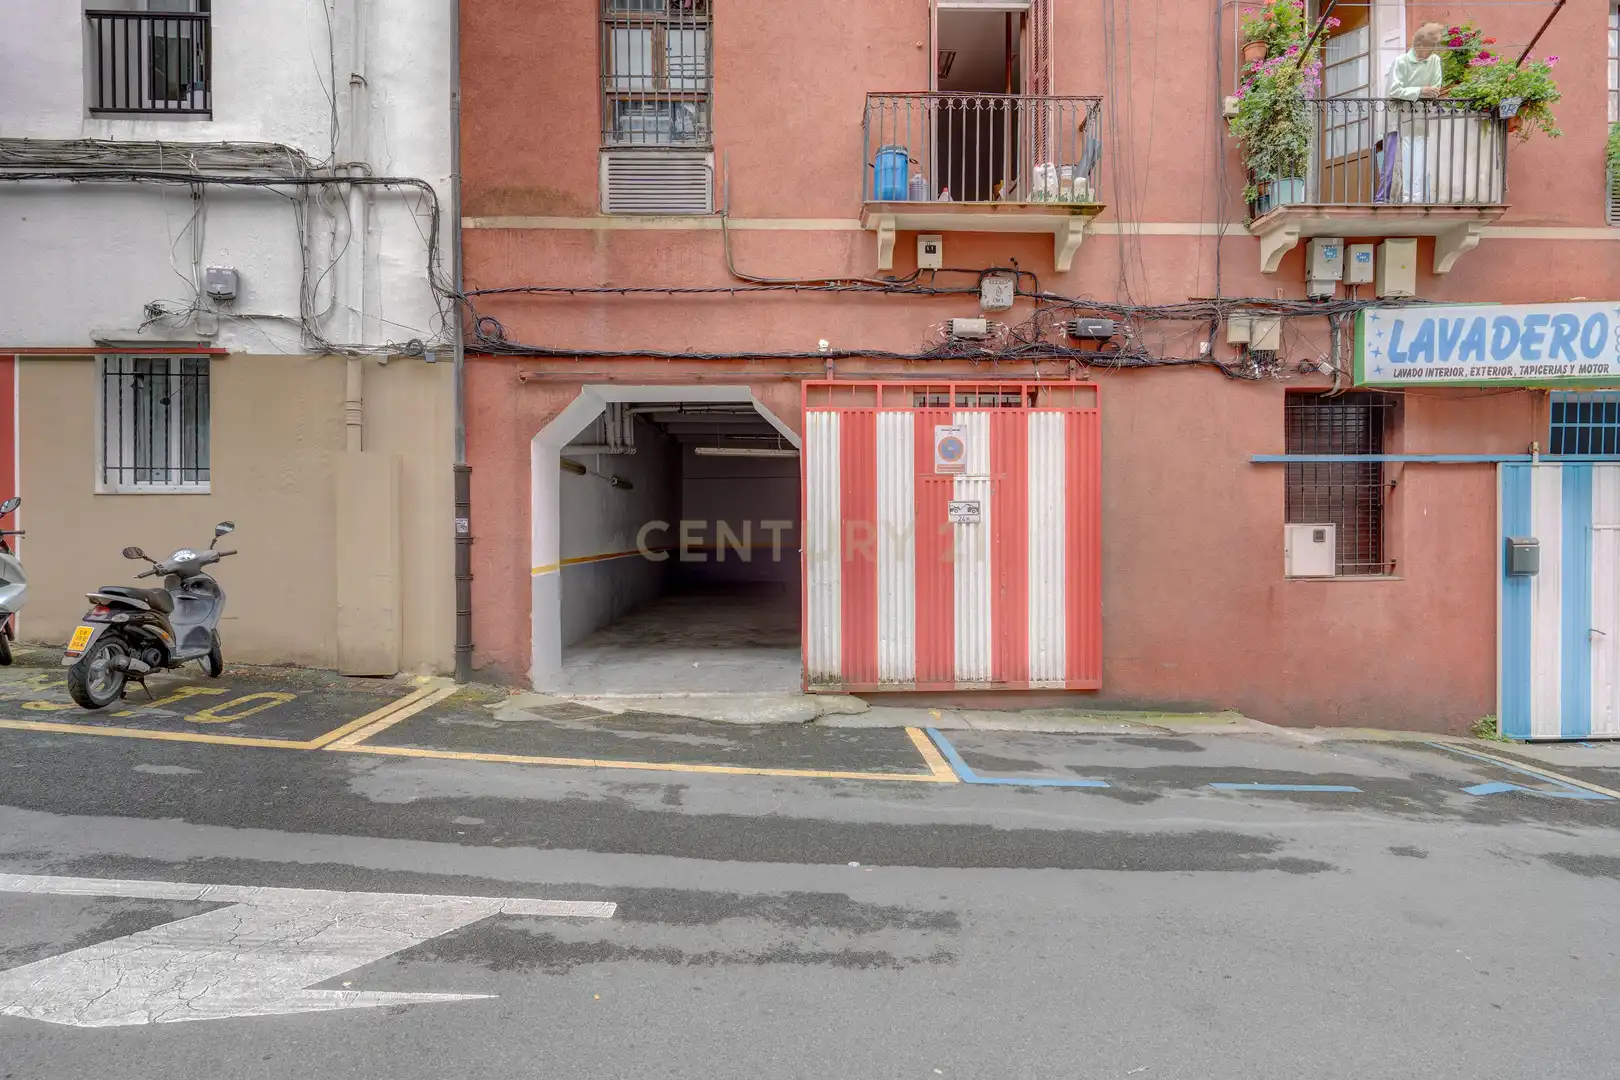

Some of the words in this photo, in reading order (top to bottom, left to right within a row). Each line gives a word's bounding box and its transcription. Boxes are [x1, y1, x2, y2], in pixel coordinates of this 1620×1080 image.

[1387, 312, 1609, 364] LAVADERO
[1393, 368, 1424, 378] LAVADO
[1425, 367, 1468, 378] INTERIOR,
[1470, 366, 1517, 377] EXTERIOR,
[1519, 364, 1568, 376] TAPICERIAS
[1569, 364, 1575, 374] Y
[1578, 363, 1610, 374] MOTOR
